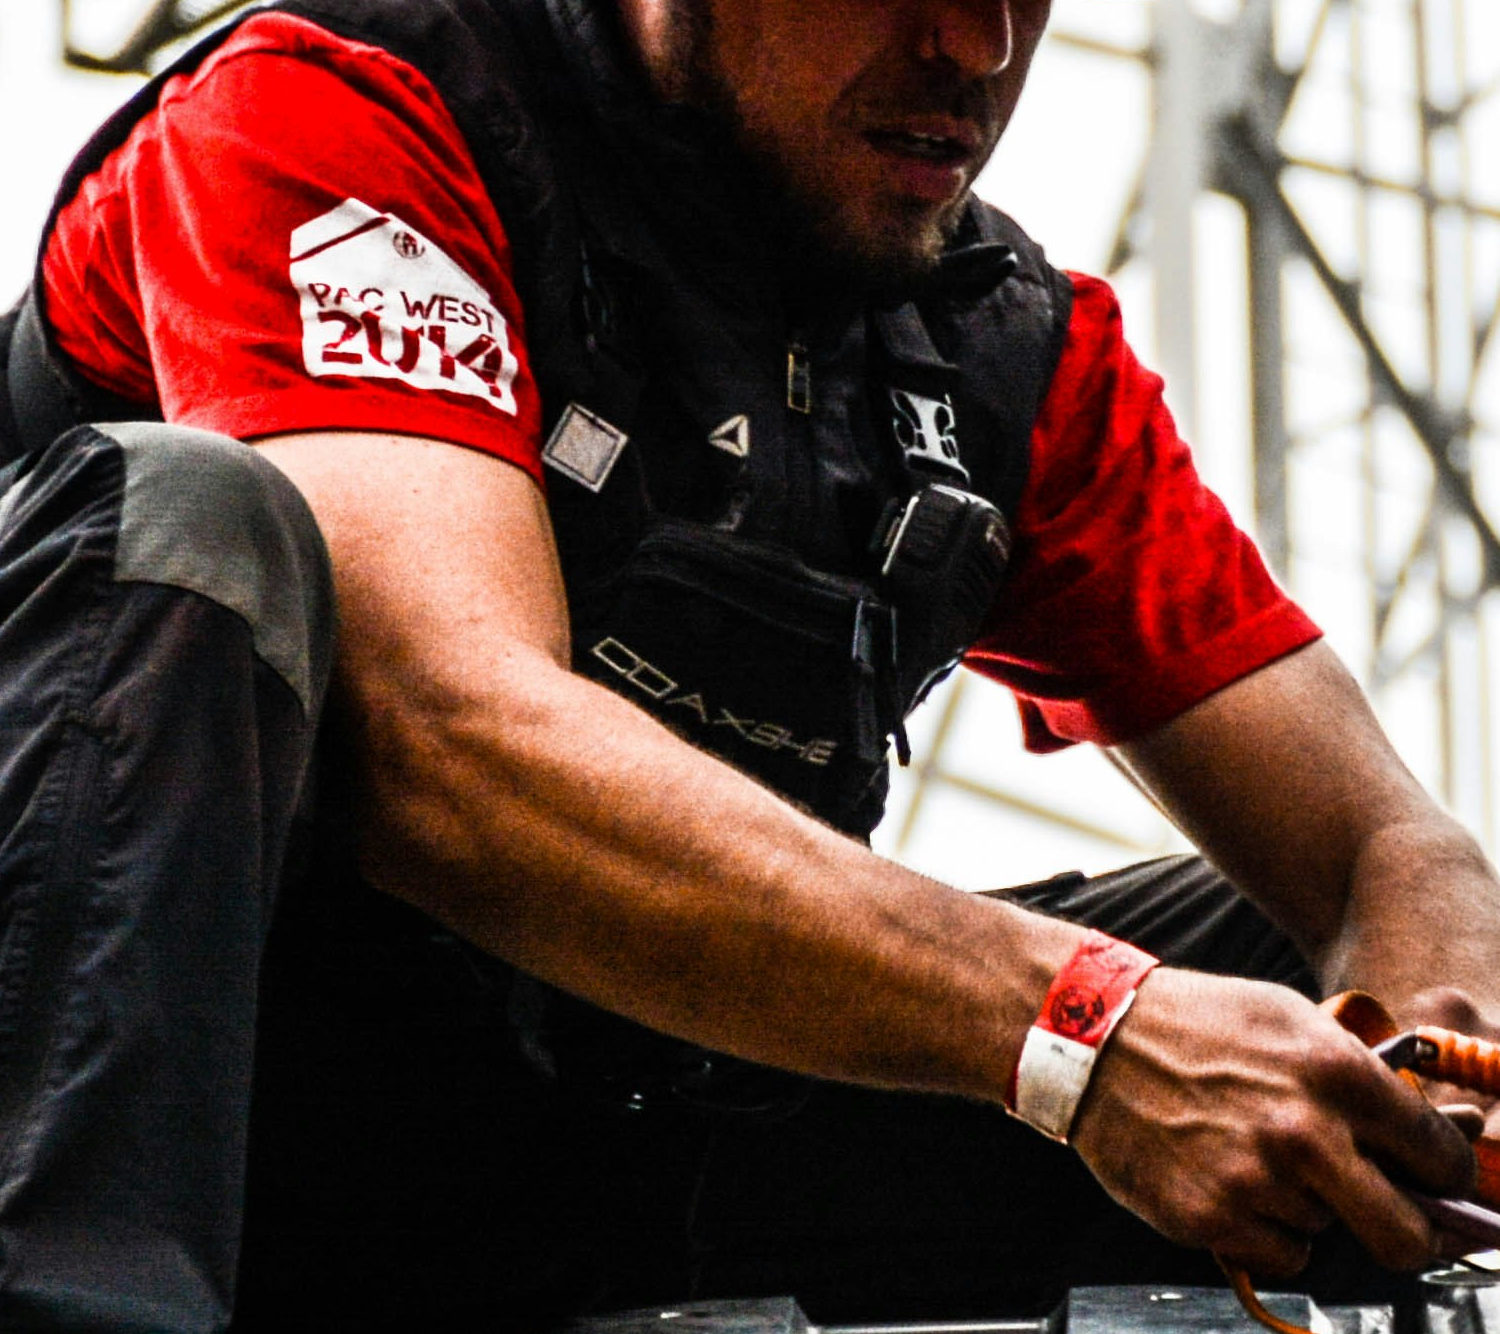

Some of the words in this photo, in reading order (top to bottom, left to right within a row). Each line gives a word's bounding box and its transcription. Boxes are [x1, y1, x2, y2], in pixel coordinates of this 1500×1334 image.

[308, 283, 384, 311] PAC
[401, 291, 494, 333] WEST
[317, 310, 503, 398] 2014
